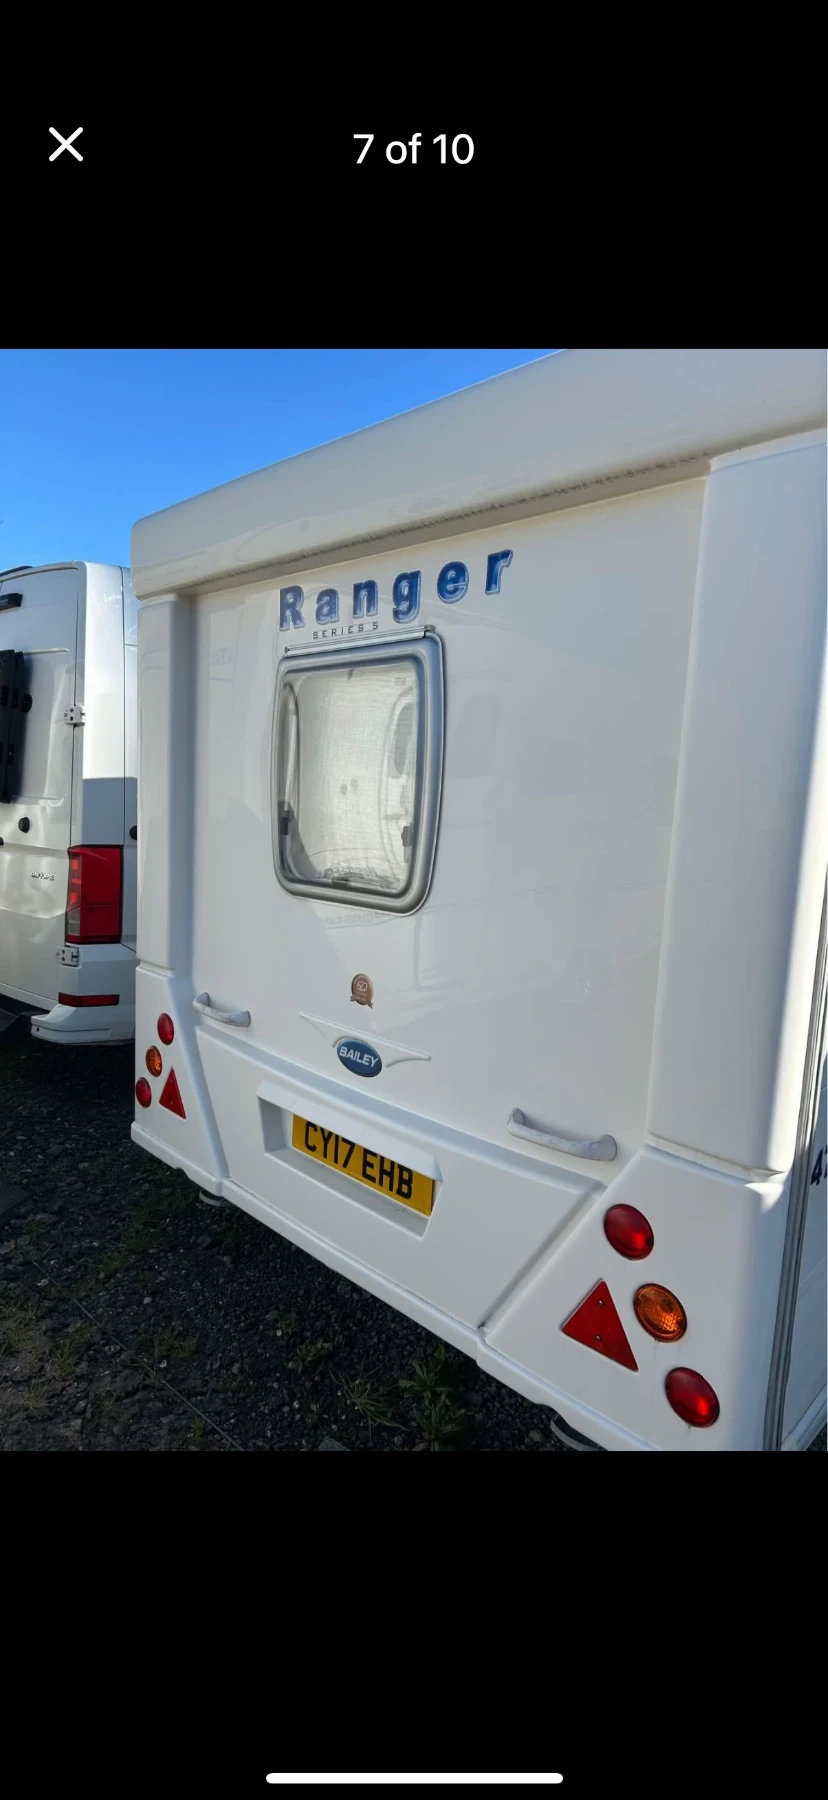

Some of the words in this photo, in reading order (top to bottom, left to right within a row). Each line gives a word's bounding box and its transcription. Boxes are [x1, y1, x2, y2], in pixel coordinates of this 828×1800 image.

[279, 549, 513, 631] Ranger
[312, 624, 364, 640] SERIES
[372, 621, 378, 631] 5
[339, 1046, 379, 1068] BAILEY
[304, 1120, 356, 1169] CY17
[361, 1147, 414, 1200] EHB
[810, 1143, 828, 1187] 4
